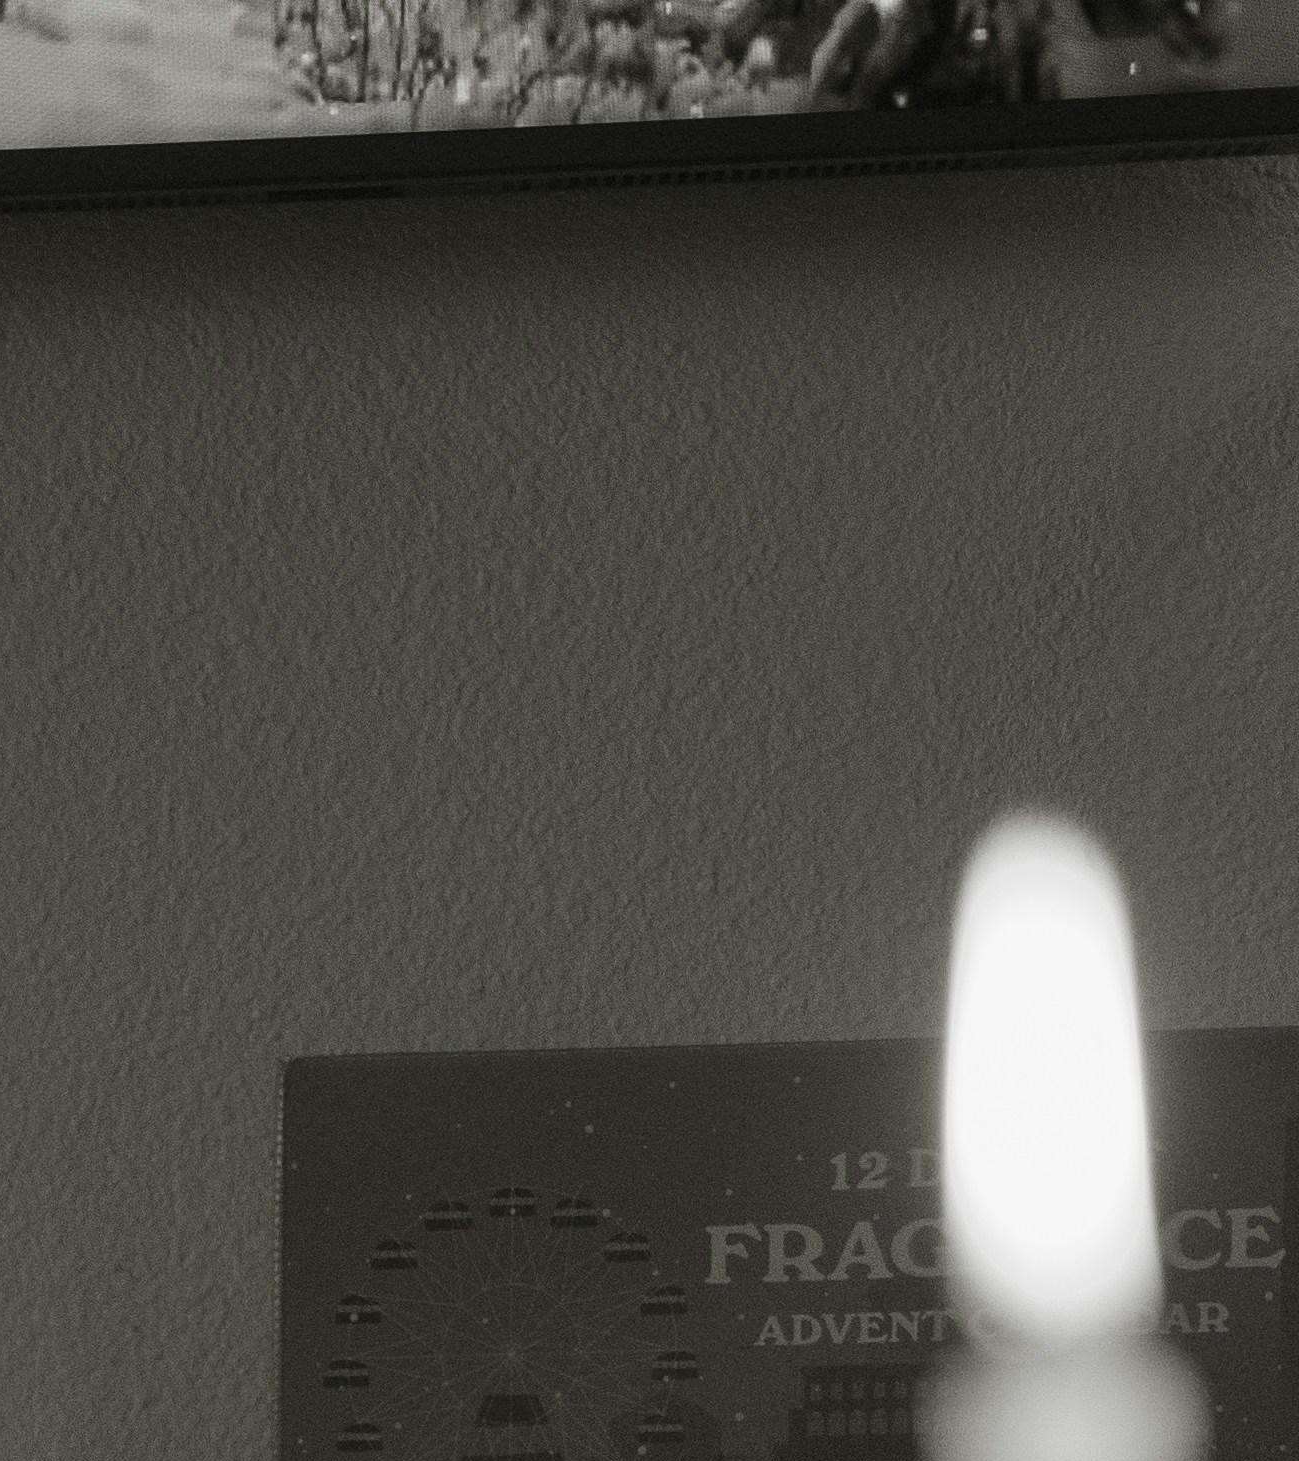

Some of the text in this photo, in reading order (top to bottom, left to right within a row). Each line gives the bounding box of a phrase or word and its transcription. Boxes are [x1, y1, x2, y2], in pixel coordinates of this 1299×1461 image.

[830, 1151, 890, 1191] 12
[704, 1205, 1287, 1285] FRAGCE
[753, 1309, 954, 1347] ADVENT
